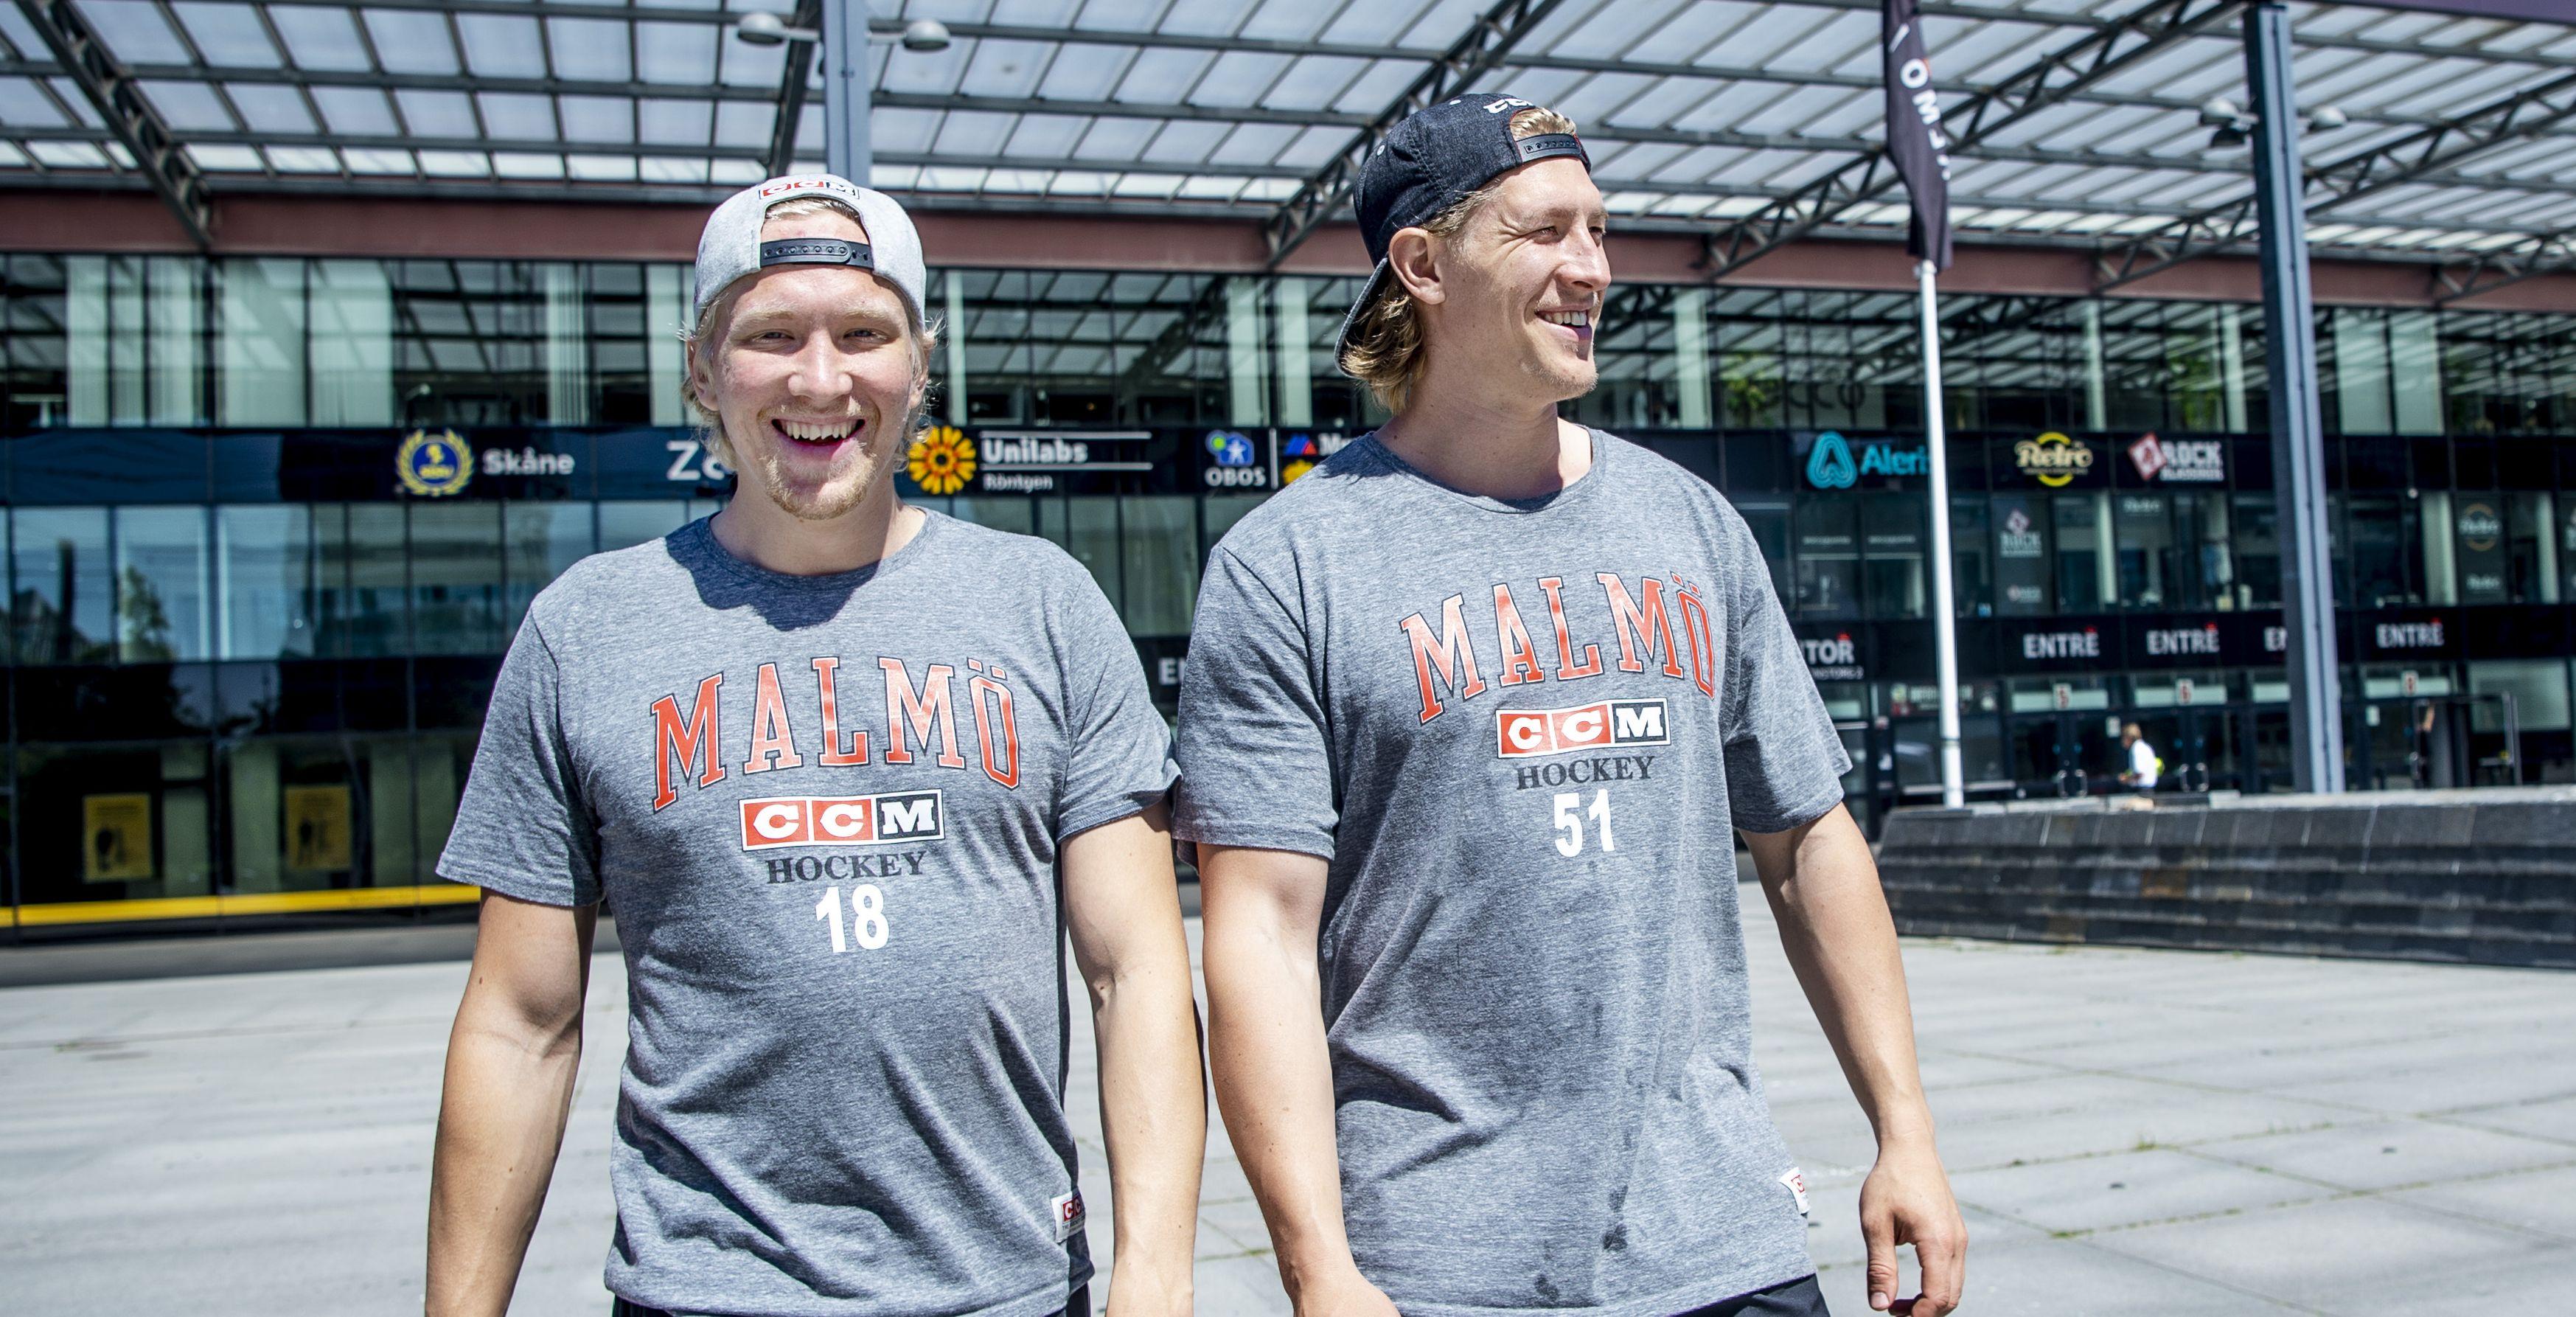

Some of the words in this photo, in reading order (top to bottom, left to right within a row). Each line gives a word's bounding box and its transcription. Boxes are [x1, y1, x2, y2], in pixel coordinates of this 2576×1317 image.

[482, 446, 576, 476] Skåne
[983, 435, 1088, 464] Unilabs
[1860, 443, 1929, 476] Aleri
[2013, 440, 2093, 468] Retro
[2161, 441, 2224, 468] ROCK
[983, 473, 1054, 493] Röntgen
[1204, 468, 1266, 487] OBOS
[1400, 571, 1715, 725] MALMÖ
[650, 656, 1019, 813] MALMÖ
[1507, 705, 1665, 750] CCM
[1516, 755, 1655, 790] HOCKEY
[752, 798, 936, 841] CCM
[1553, 788, 1615, 858] 51
[765, 850, 927, 883] HOCKEY
[815, 883, 890, 953] 18
